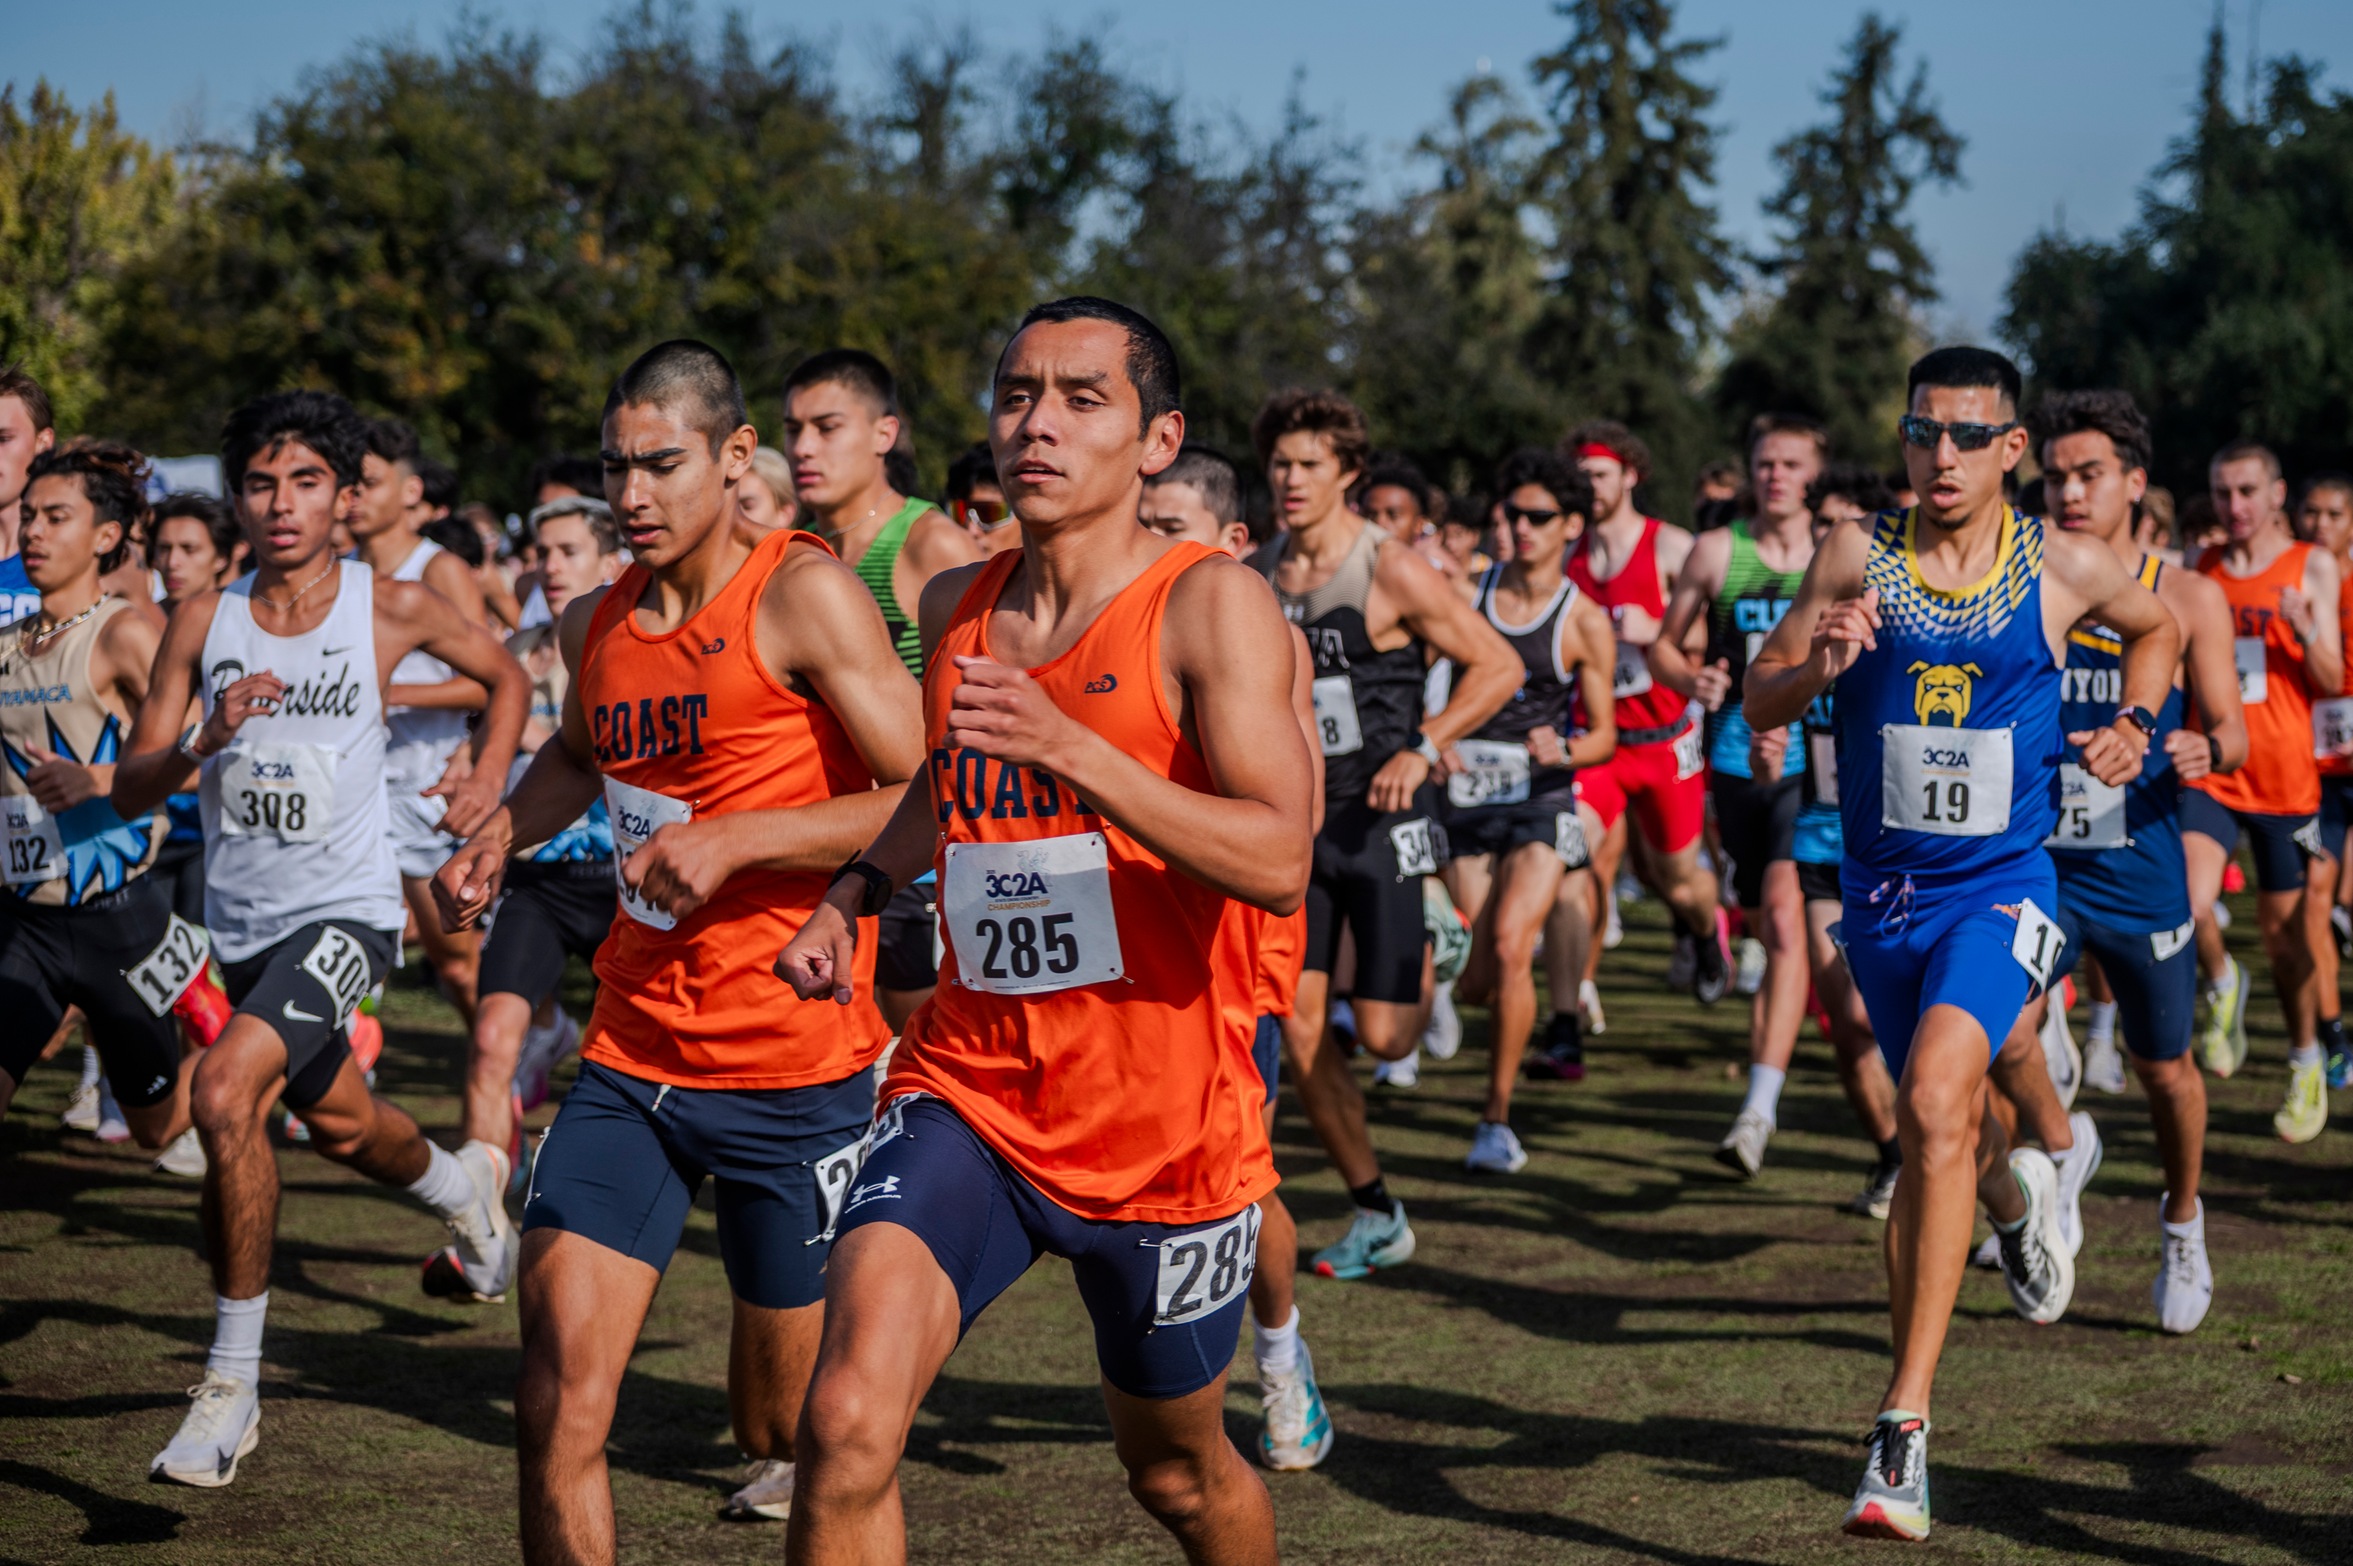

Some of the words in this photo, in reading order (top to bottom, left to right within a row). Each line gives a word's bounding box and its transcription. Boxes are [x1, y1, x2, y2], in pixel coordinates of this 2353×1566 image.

[593, 693, 707, 763] COAST
[251, 760, 295, 779] 3C2A
[1922, 748, 1970, 768] 3C2A
[931, 748, 1095, 824] COAS
[1922, 781, 1971, 823] 19
[240, 789, 306, 832] 308
[8, 835, 50, 874] 132
[985, 872, 1048, 898] 3C2A
[987, 899, 1051, 911] CHAMPIONSHIP
[140, 924, 203, 1005] 132
[976, 912, 1079, 979] 285
